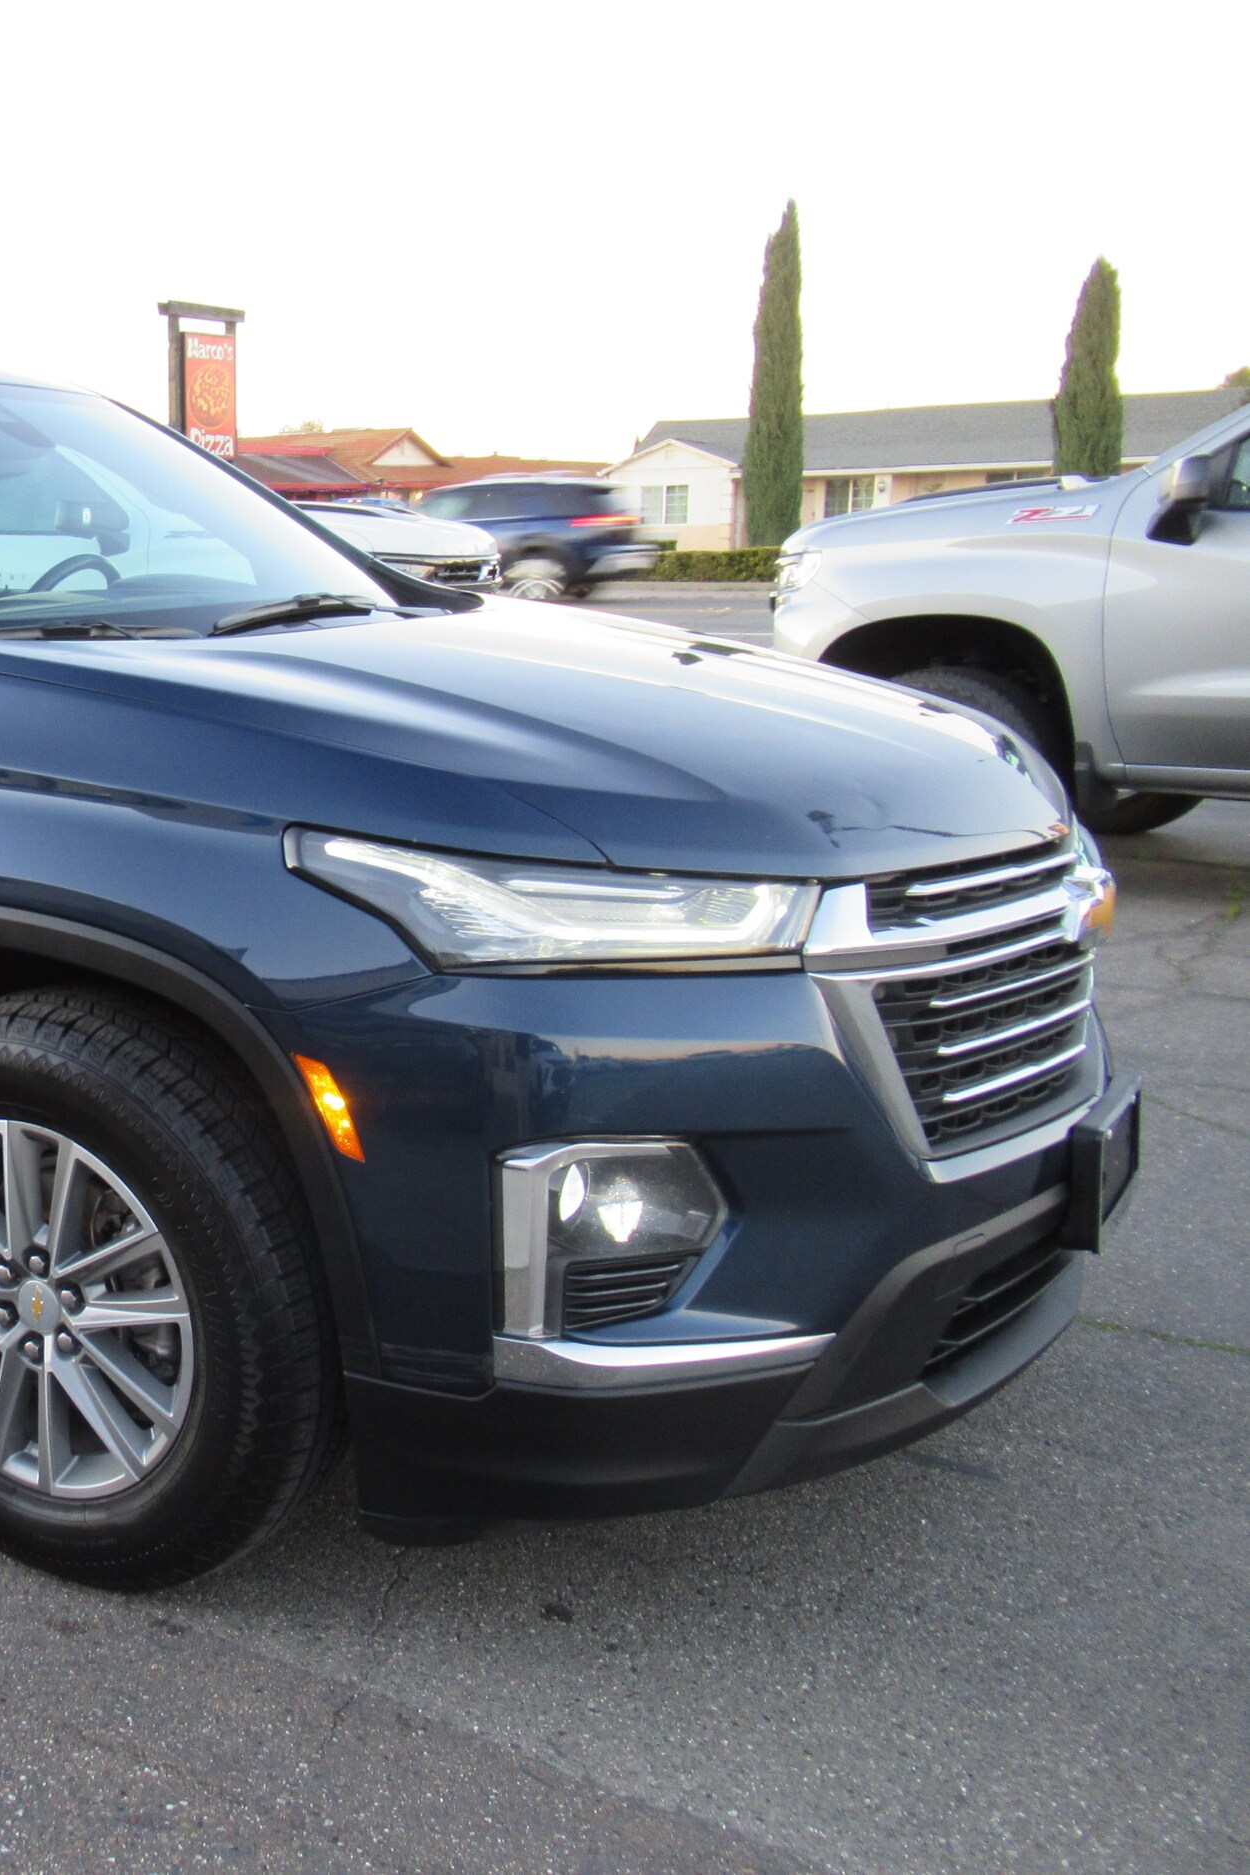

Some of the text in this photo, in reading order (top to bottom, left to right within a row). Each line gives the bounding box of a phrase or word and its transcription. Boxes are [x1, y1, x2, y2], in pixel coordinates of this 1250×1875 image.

[186, 337, 234, 361] Marco's
[189, 427, 234, 456] Pizza
[1007, 504, 1101, 525] Z71
